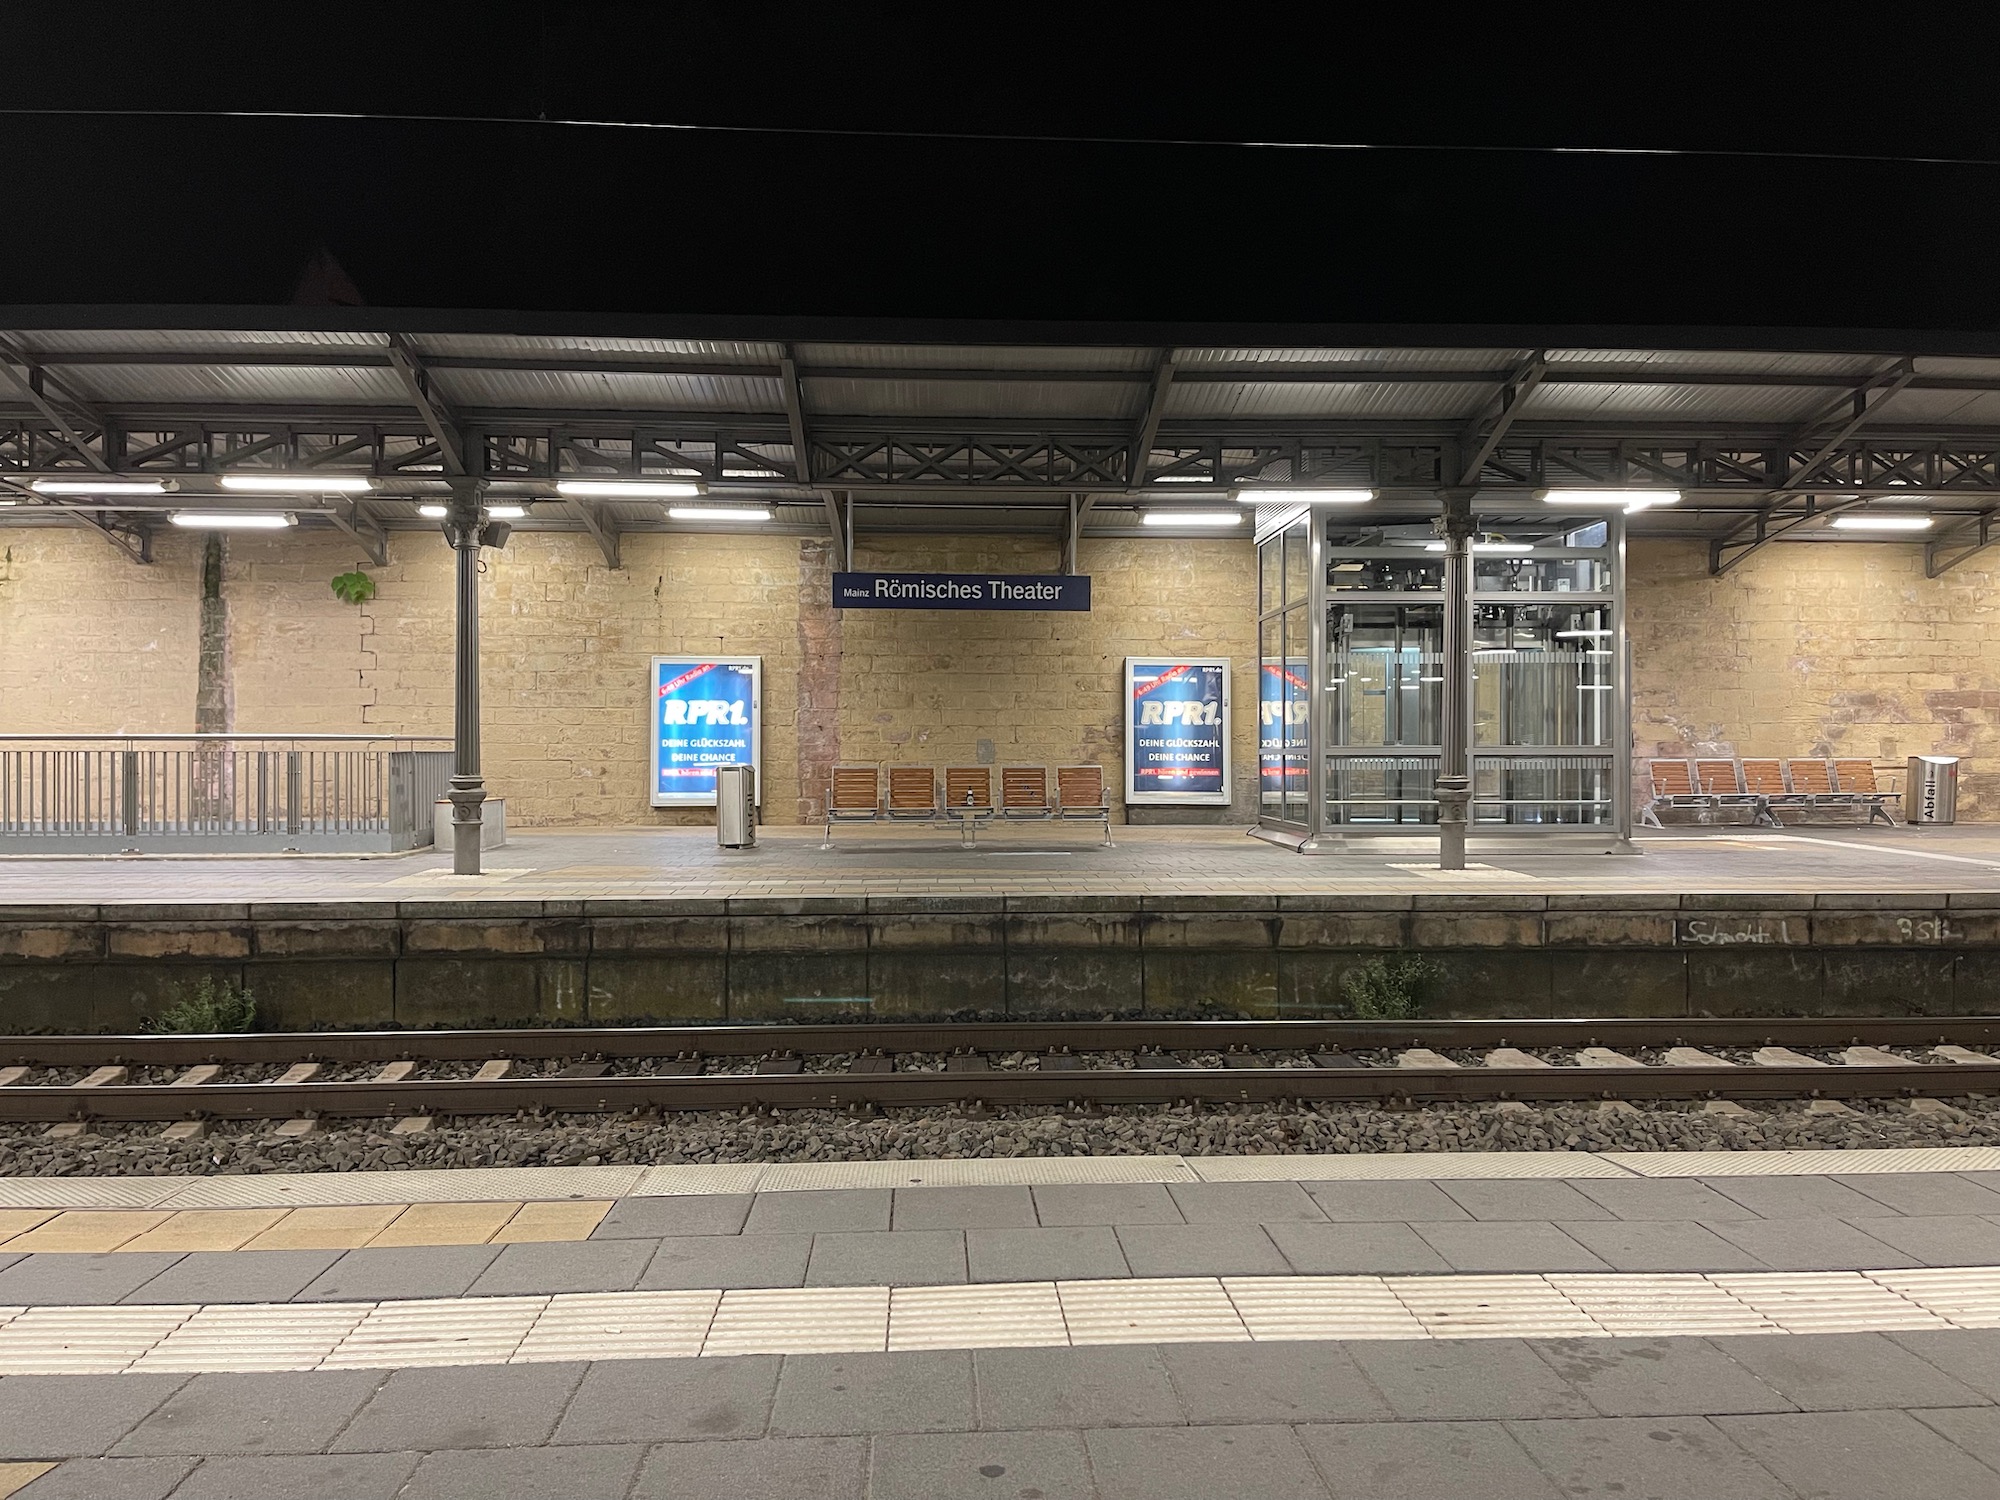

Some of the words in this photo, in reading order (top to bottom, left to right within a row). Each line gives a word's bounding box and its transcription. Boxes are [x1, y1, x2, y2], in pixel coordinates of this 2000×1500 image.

[843, 588, 870, 598] Mainz
[874, 578, 983, 600] Römisches
[987, 580, 1063, 600] Theater
[662, 739, 688, 747] DEINE
[690, 738, 746, 747] GLÜCKSZAHL
[1140, 739, 1164, 747] DEINE
[1166, 738, 1220, 748] GLÜCKSZAHL
[671, 754, 698, 762] DEINE
[700, 754, 736, 762] CHANCE
[1149, 753, 1174, 761] DEINE
[1190, 769, 1219, 777] gewinnen
[1925, 781, 1935, 818] Abfall
